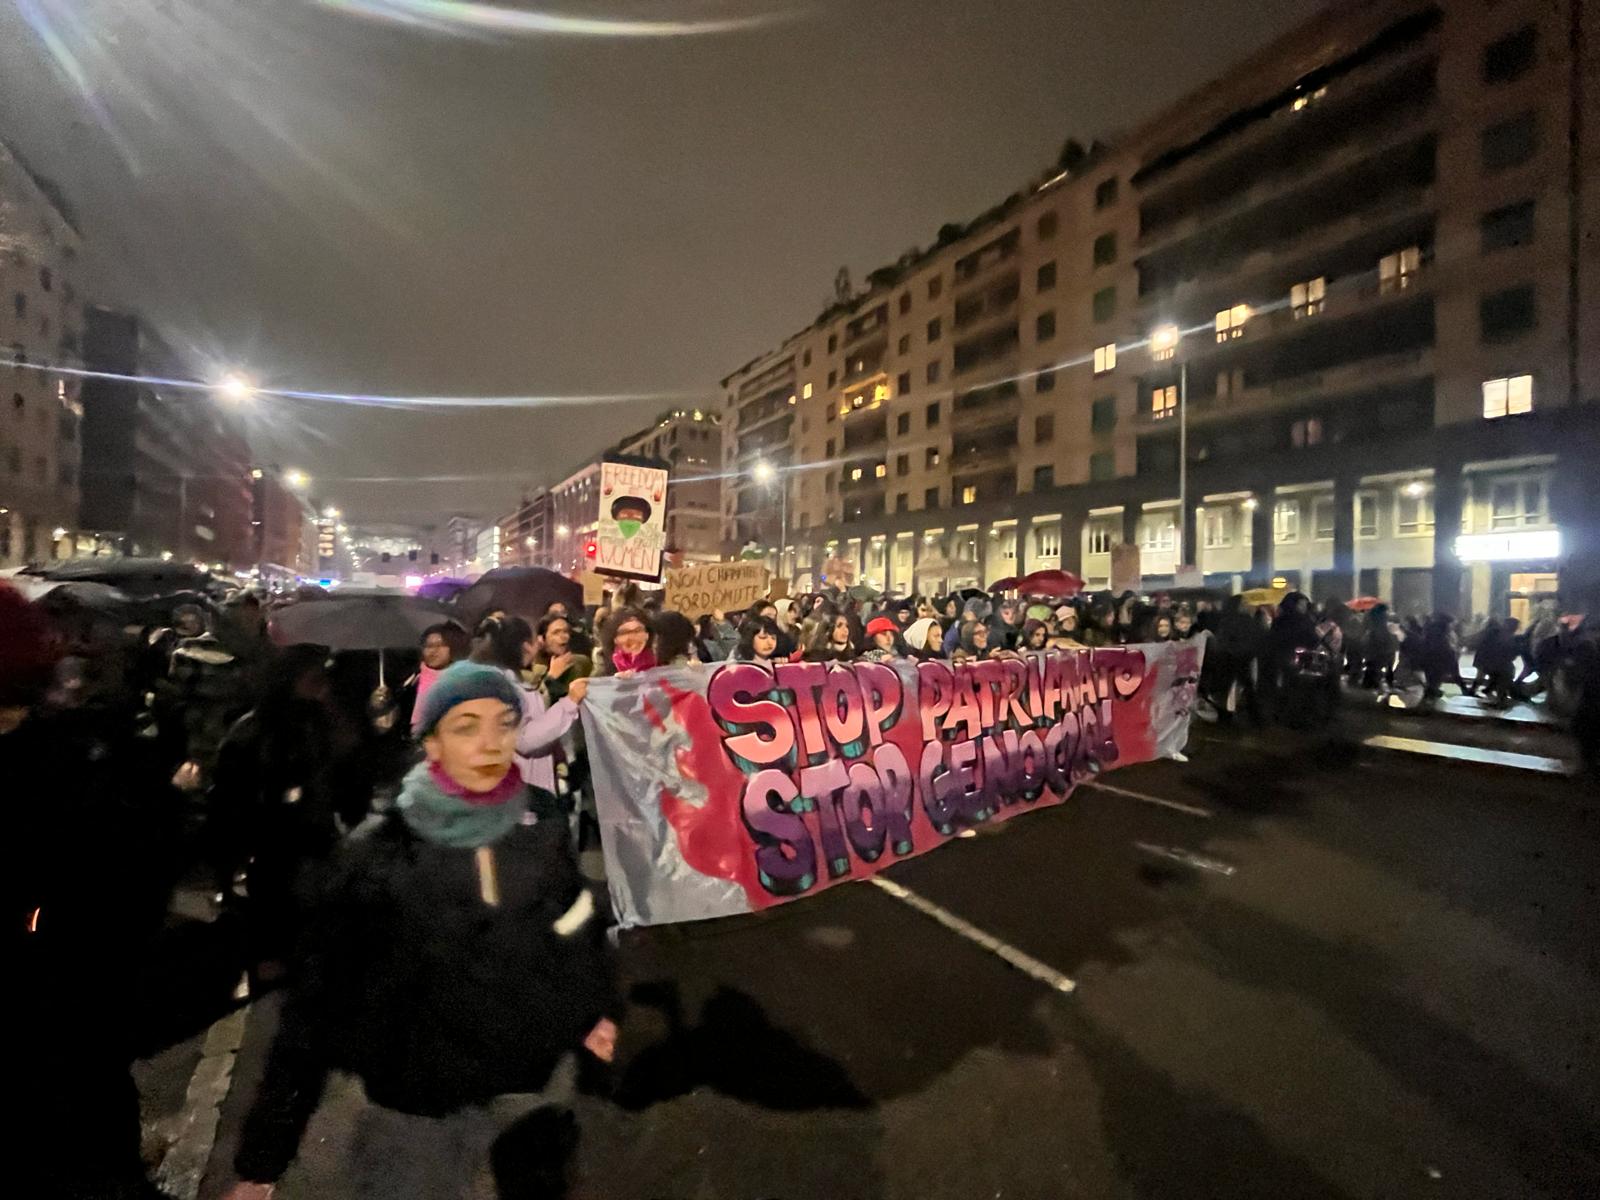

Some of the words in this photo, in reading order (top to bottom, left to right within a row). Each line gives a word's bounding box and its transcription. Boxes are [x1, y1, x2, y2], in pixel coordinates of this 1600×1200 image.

[600, 536, 656, 573] WOMEN
[708, 662, 904, 772] STOP
[740, 743, 914, 896] STOP
